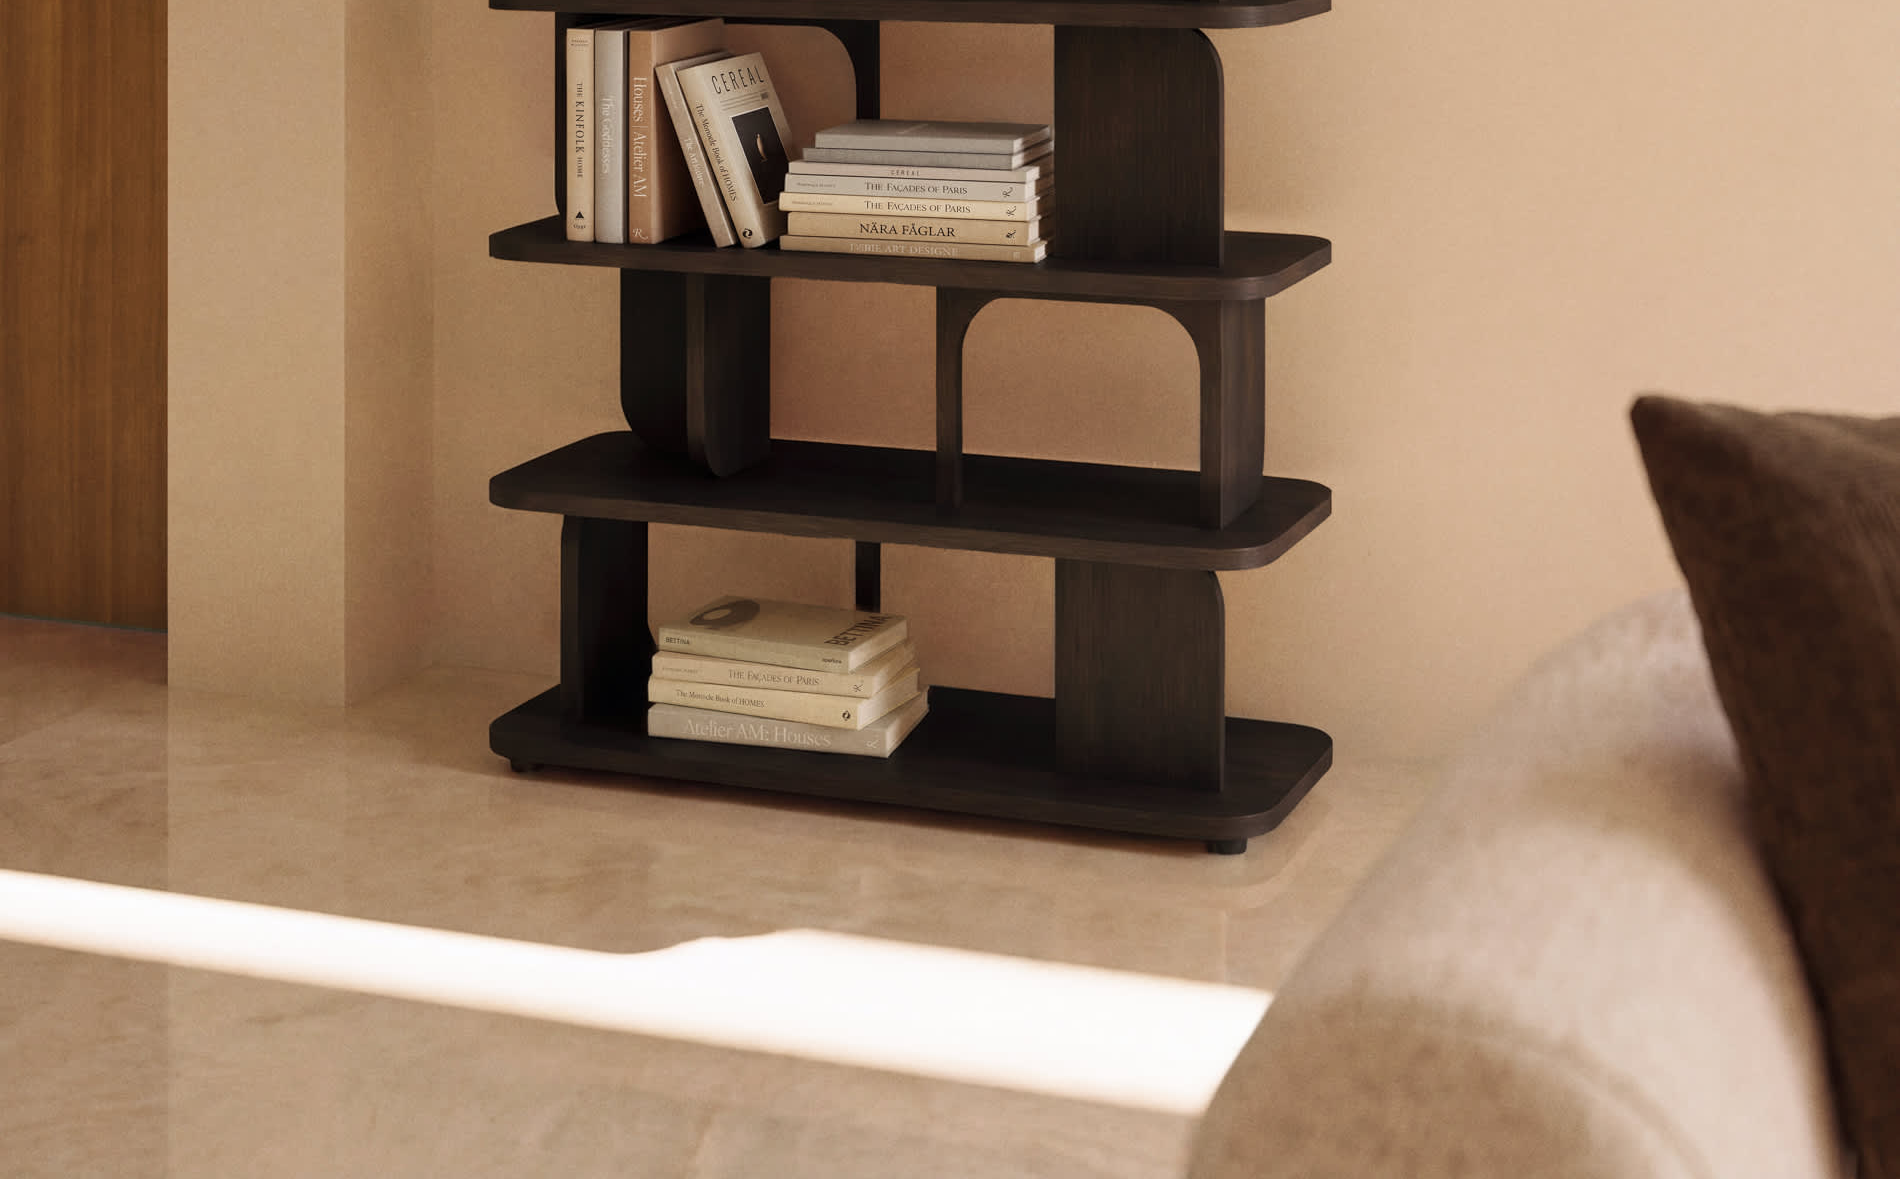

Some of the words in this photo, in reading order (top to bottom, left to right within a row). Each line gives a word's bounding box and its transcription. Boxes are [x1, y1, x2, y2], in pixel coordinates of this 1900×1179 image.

[711, 66, 765, 94] CEREAL
[632, 77, 648, 123] Houses
[576, 101, 585, 153] KINFOLK
[633, 131, 648, 172] Atelier
[696, 103, 706, 119] The
[711, 145, 724, 164] Book
[723, 172, 737, 202] HOMES
[633, 174, 648, 197] AM
[864, 181, 882, 191] THE
[887, 183, 925, 194] FAÇADES
[927, 185, 939, 194] OF
[942, 186, 968, 195] PARIS
[864, 201, 884, 210] THE
[887, 201, 927, 213] FAÇADES
[930, 204, 942, 213] OF
[945, 204, 971, 214] PARIS
[860, 222, 898, 235] NÄRA
[902, 221, 956, 237] FÅGLAR
[885, 244, 907, 254] ART
[665, 636, 690, 645] BETTINA
[824, 613, 893, 646] BETTINA
[728, 669, 745, 680] THE
[796, 675, 820, 685] PARIS
[676, 689, 688, 698] The
[739, 698, 765, 708] HOMES
[683, 719, 737, 738] Atelier
[737, 723, 769, 740] AM:
[774, 726, 832, 747] Houses
